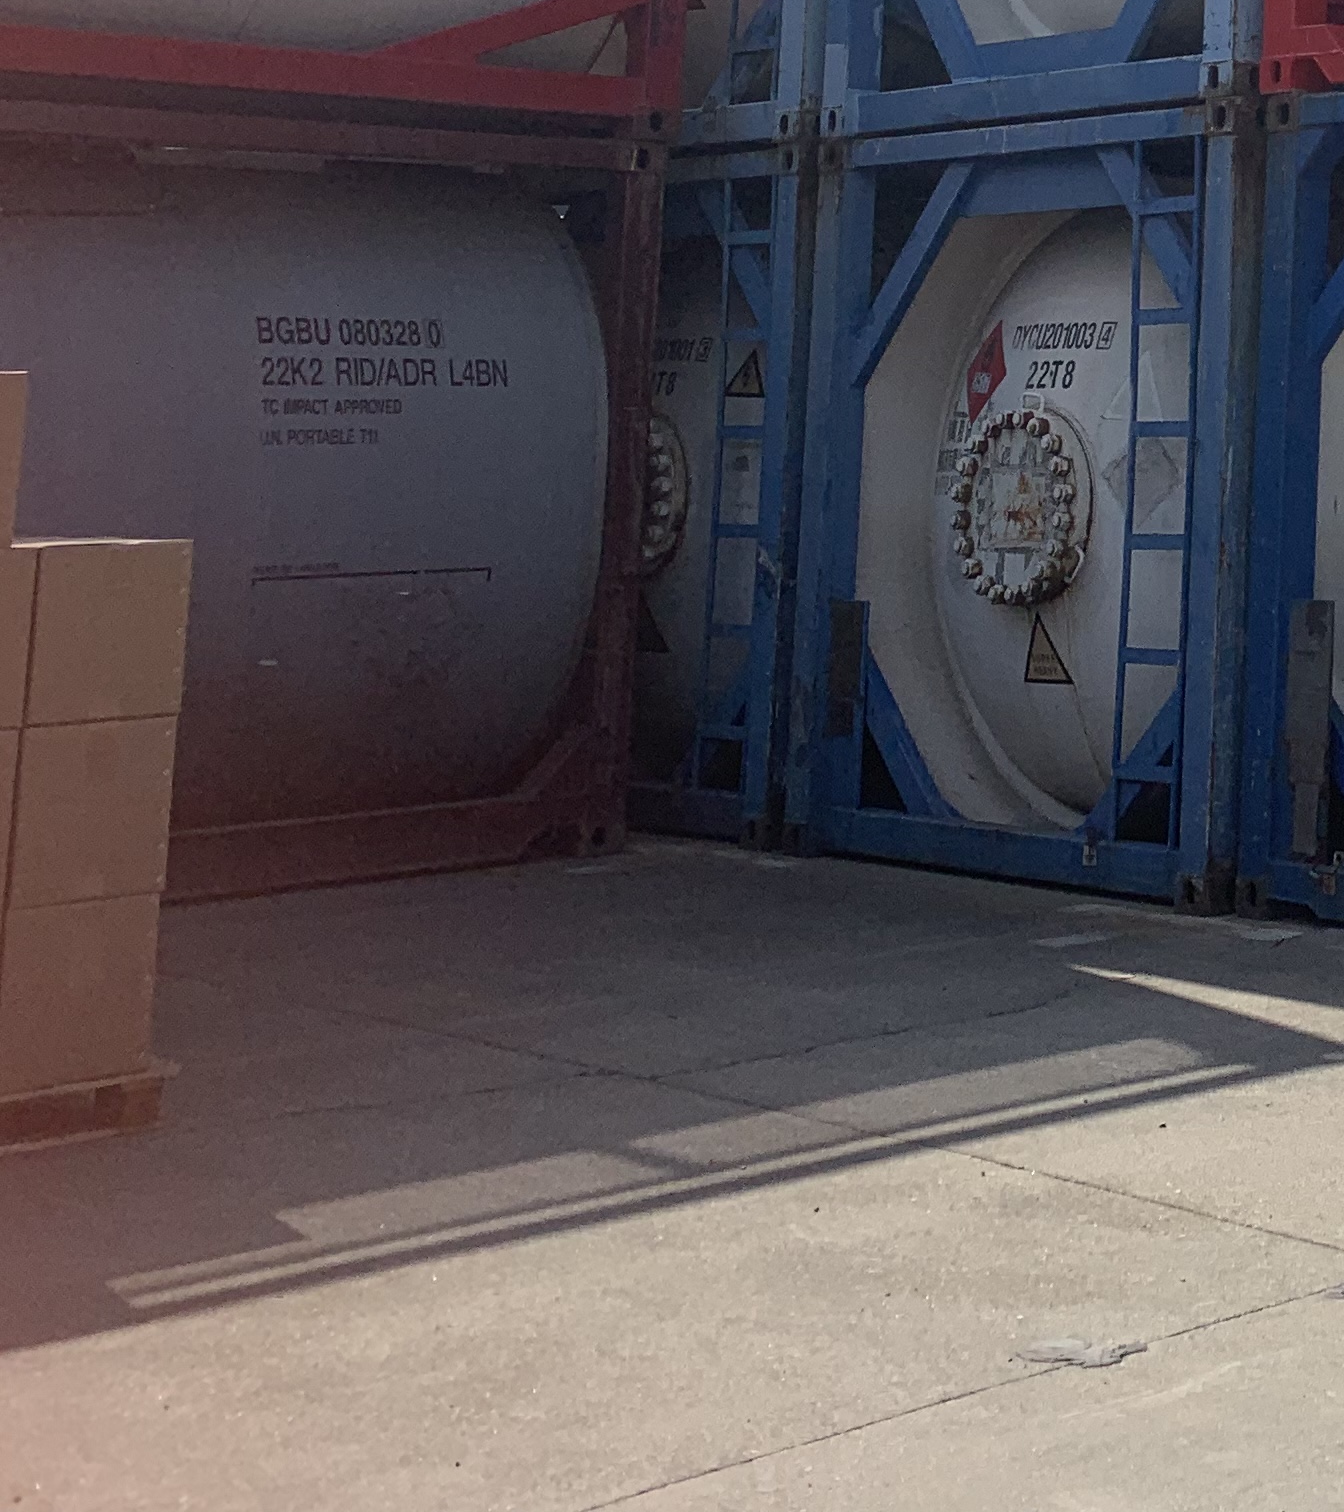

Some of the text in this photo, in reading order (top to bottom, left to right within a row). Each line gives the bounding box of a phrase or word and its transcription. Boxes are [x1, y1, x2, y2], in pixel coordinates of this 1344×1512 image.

[256, 316, 331, 345] BGBU
[339, 318, 421, 346] 080328
[261, 357, 508, 388] 22K2 RID/ADR L4BN
[1025, 360, 1076, 389] 22T8
